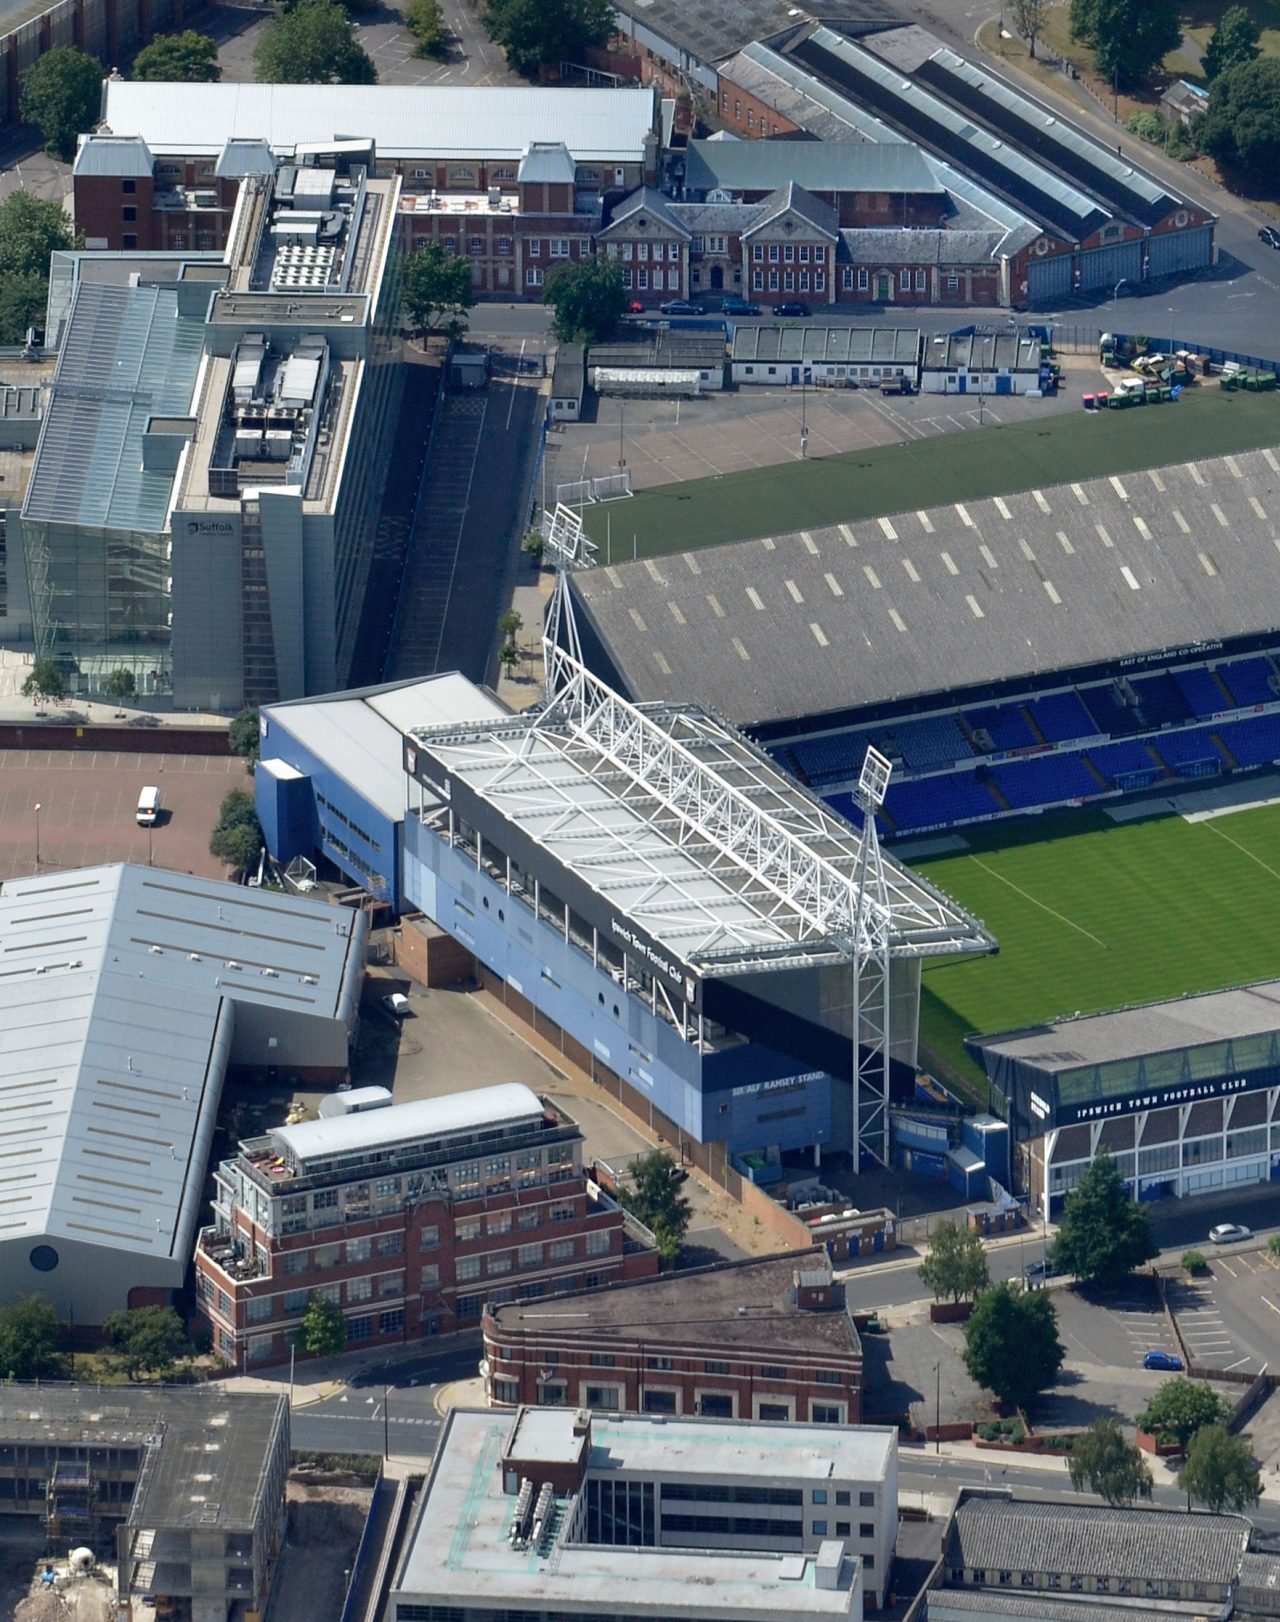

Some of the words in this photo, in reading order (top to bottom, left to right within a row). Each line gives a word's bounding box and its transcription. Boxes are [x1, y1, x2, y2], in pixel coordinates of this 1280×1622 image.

[200, 522, 234, 531] Suffolk
[1119, 658, 1136, 667] EAST
[1147, 651, 1177, 662] ENGLAND
[746, 1083, 761, 1093] ALF
[764, 1076, 796, 1090] RAMSEY
[798, 1070, 825, 1084] STAND
[1077, 1102, 1122, 1118] IPSWICH
[1128, 1096, 1158, 1108] TOWN
[1163, 1085, 1215, 1102] FOOTBALL
[1221, 1079, 1247, 1090] CLUB
